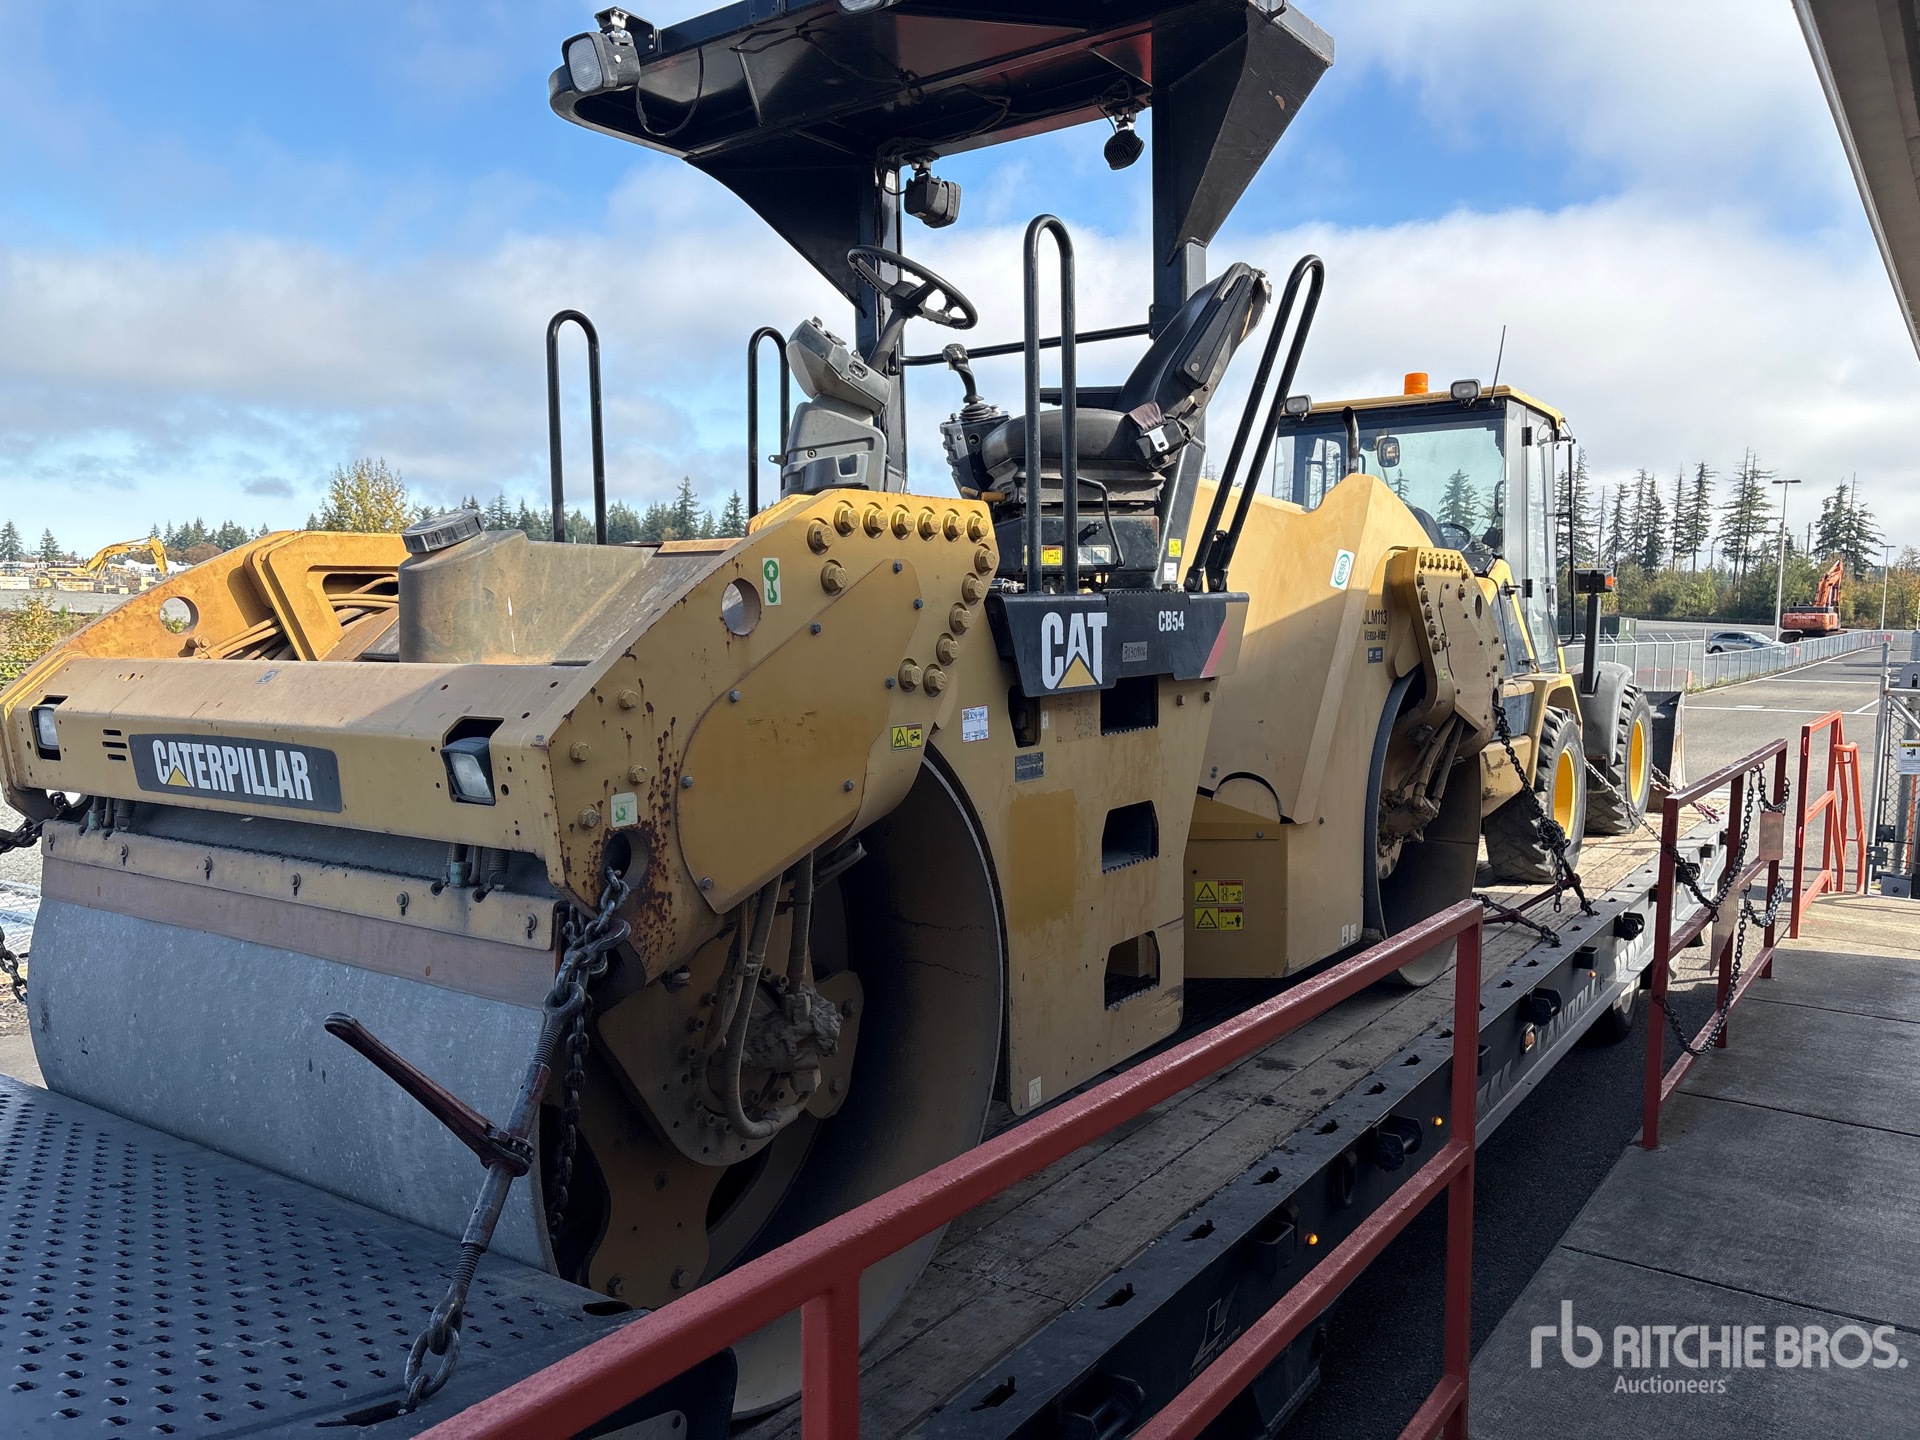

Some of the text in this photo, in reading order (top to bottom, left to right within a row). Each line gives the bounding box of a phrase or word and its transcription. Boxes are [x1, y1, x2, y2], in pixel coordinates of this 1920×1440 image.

[1337, 559, 1348, 581] DIESEL
[1041, 611, 1108, 690] CAT
[1158, 610, 1185, 632] CB54
[152, 739, 313, 801] CATERPILLAR
[1536, 977, 1599, 1055] LANDOLL
